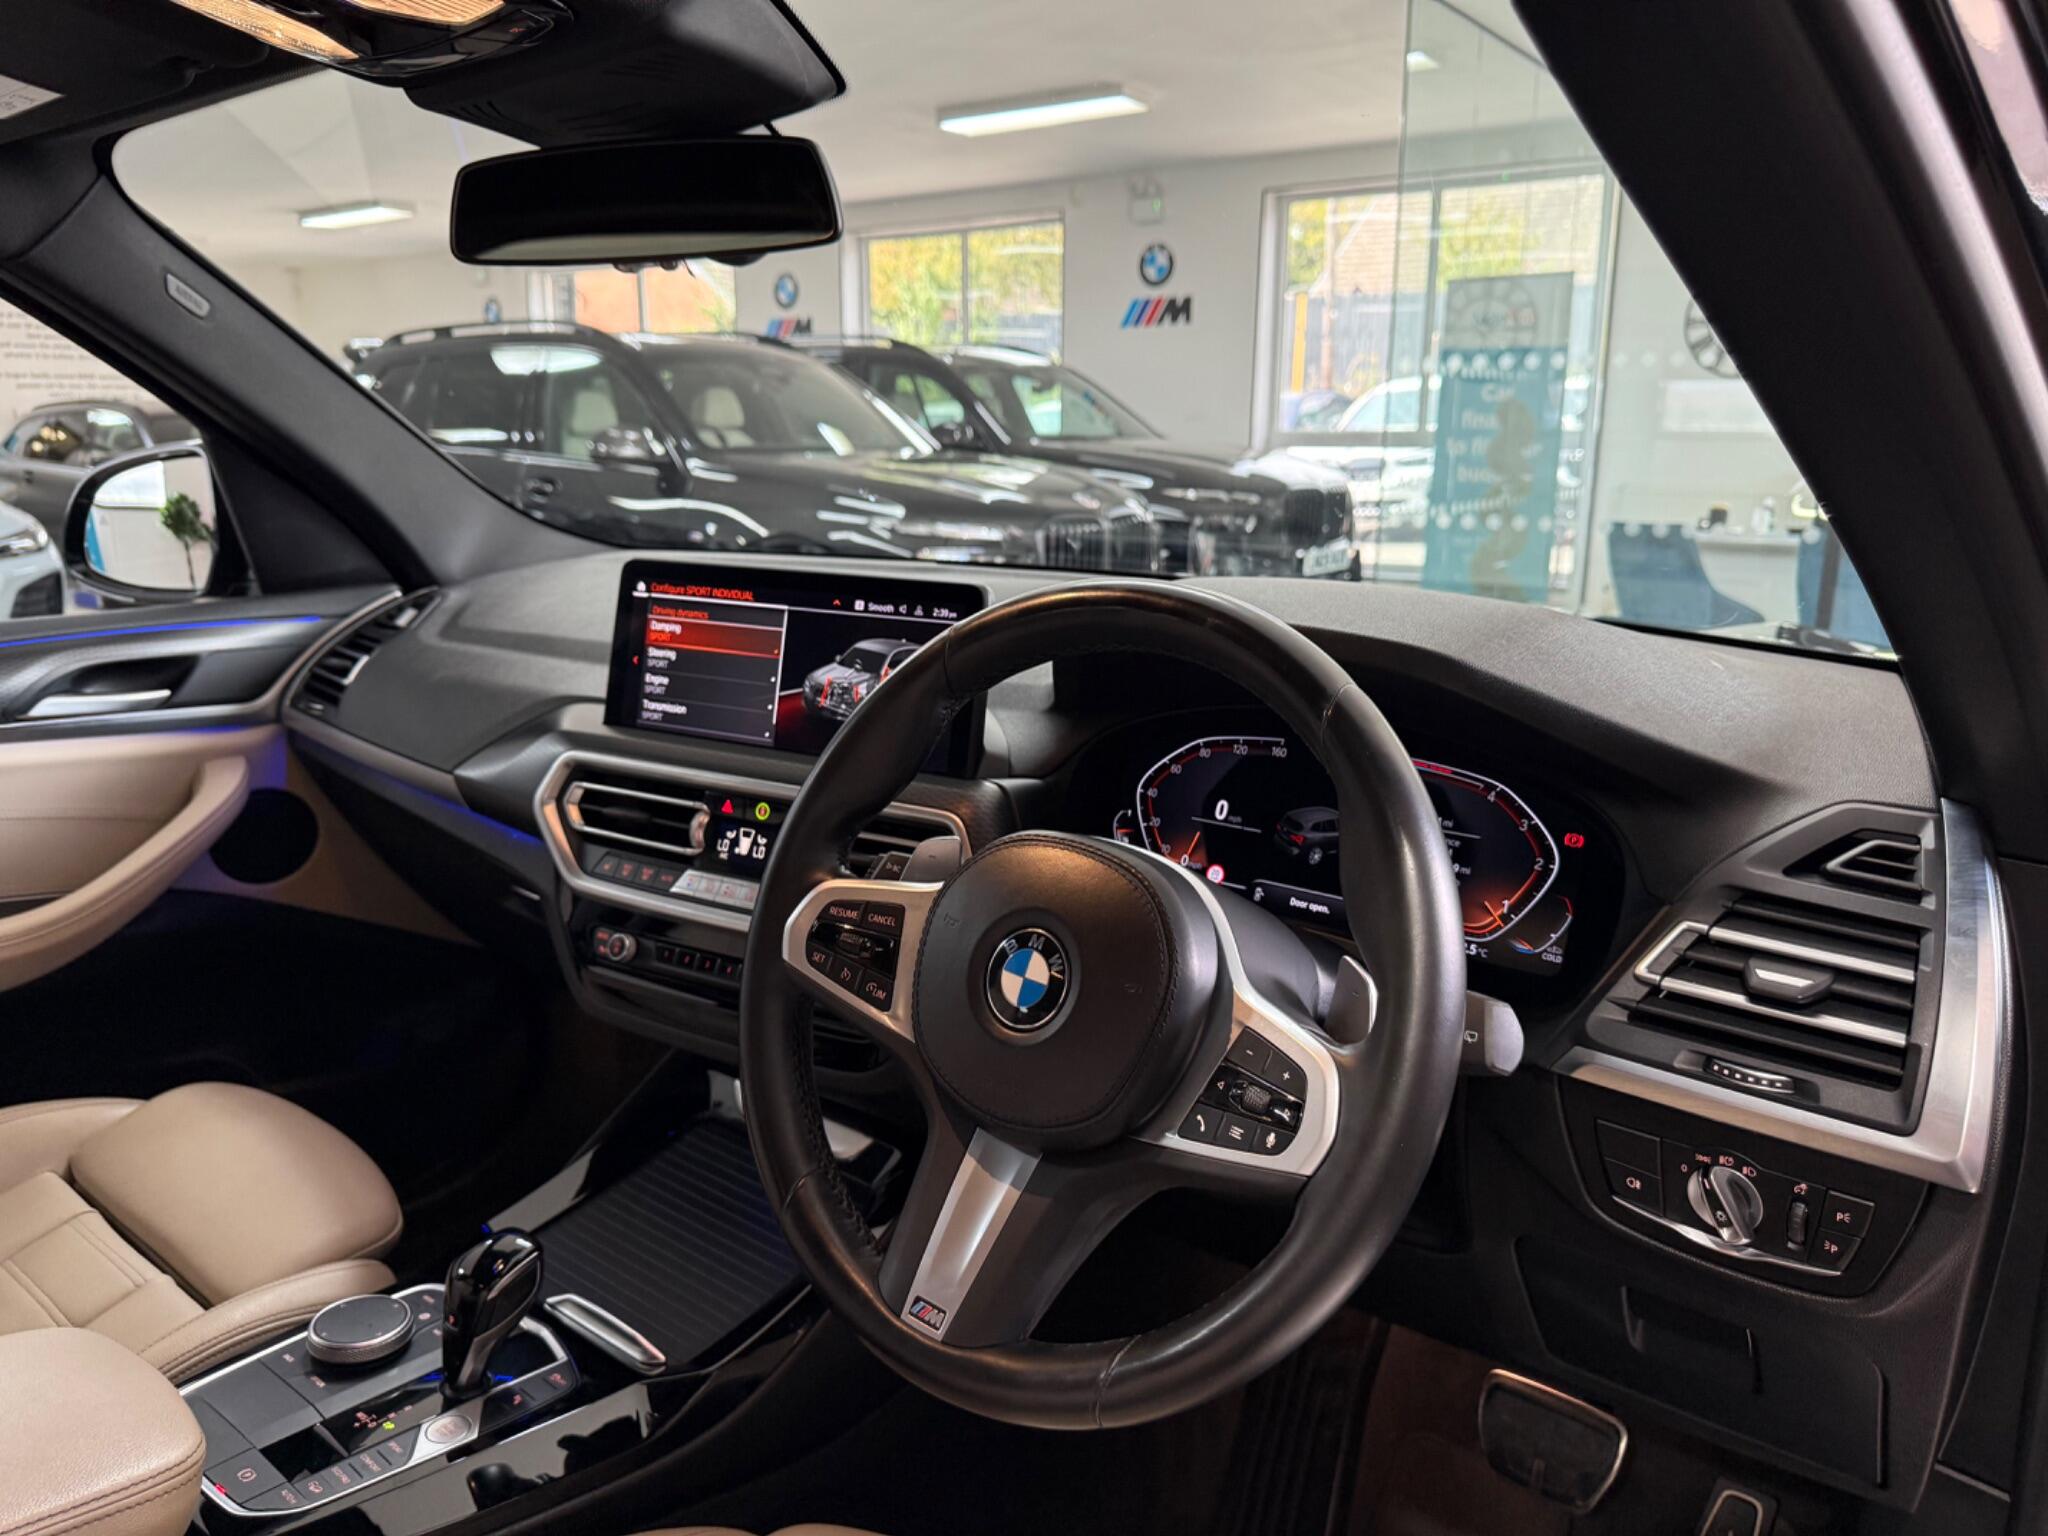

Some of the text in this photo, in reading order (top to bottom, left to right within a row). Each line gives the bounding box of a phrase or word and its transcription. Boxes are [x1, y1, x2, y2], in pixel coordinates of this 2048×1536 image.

[651, 583, 754, 600] Configure SPORT INDIVIDUAL
[653, 606, 709, 620] Driving dynamics
[868, 602, 895, 613] Smooth
[650, 620, 682, 635] Damping
[649, 632, 671, 642] SPORT
[647, 647, 677, 661] Steering
[647, 658, 669, 668] SPORT
[644, 673, 670, 686] Engine
[643, 684, 667, 695] SPORT
[642, 699, 688, 715] Transmission
[641, 710, 663, 720] SPORT
[1233, 744, 1248, 755] 120
[1487, 791, 1496, 802] 4
[1214, 799, 1229, 820] 0
[1150, 816, 1161, 827] 20
[1519, 819, 1529, 831] 3
[1181, 854, 1189, 866] 0
[1533, 857, 1544, 870] 2
[1289, 897, 1330, 914] Door open.
[1502, 899, 1509, 914] 1
[829, 905, 896, 927] RESUME CANCEL
[812, 951, 826, 963] SET
[1541, 953, 1563, 964] COLD
